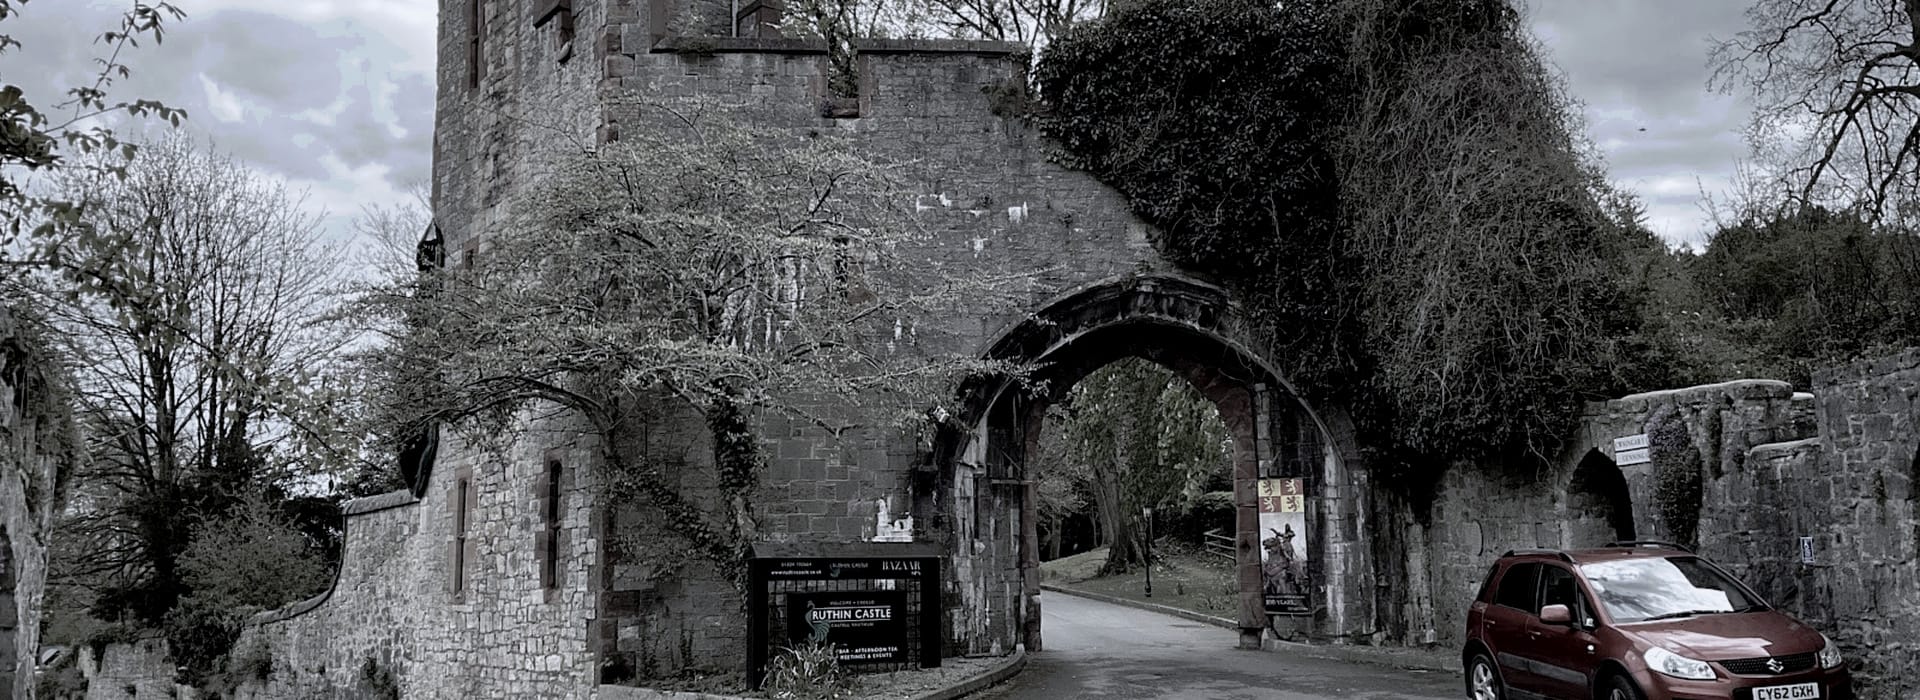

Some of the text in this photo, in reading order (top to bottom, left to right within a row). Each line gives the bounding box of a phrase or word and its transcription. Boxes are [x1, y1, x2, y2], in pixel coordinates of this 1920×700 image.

[882, 560, 921, 571] BAZAAR
[812, 608, 891, 620] RUTHIN CASTLE
[1758, 685, 1814, 700] CY62 GXH
